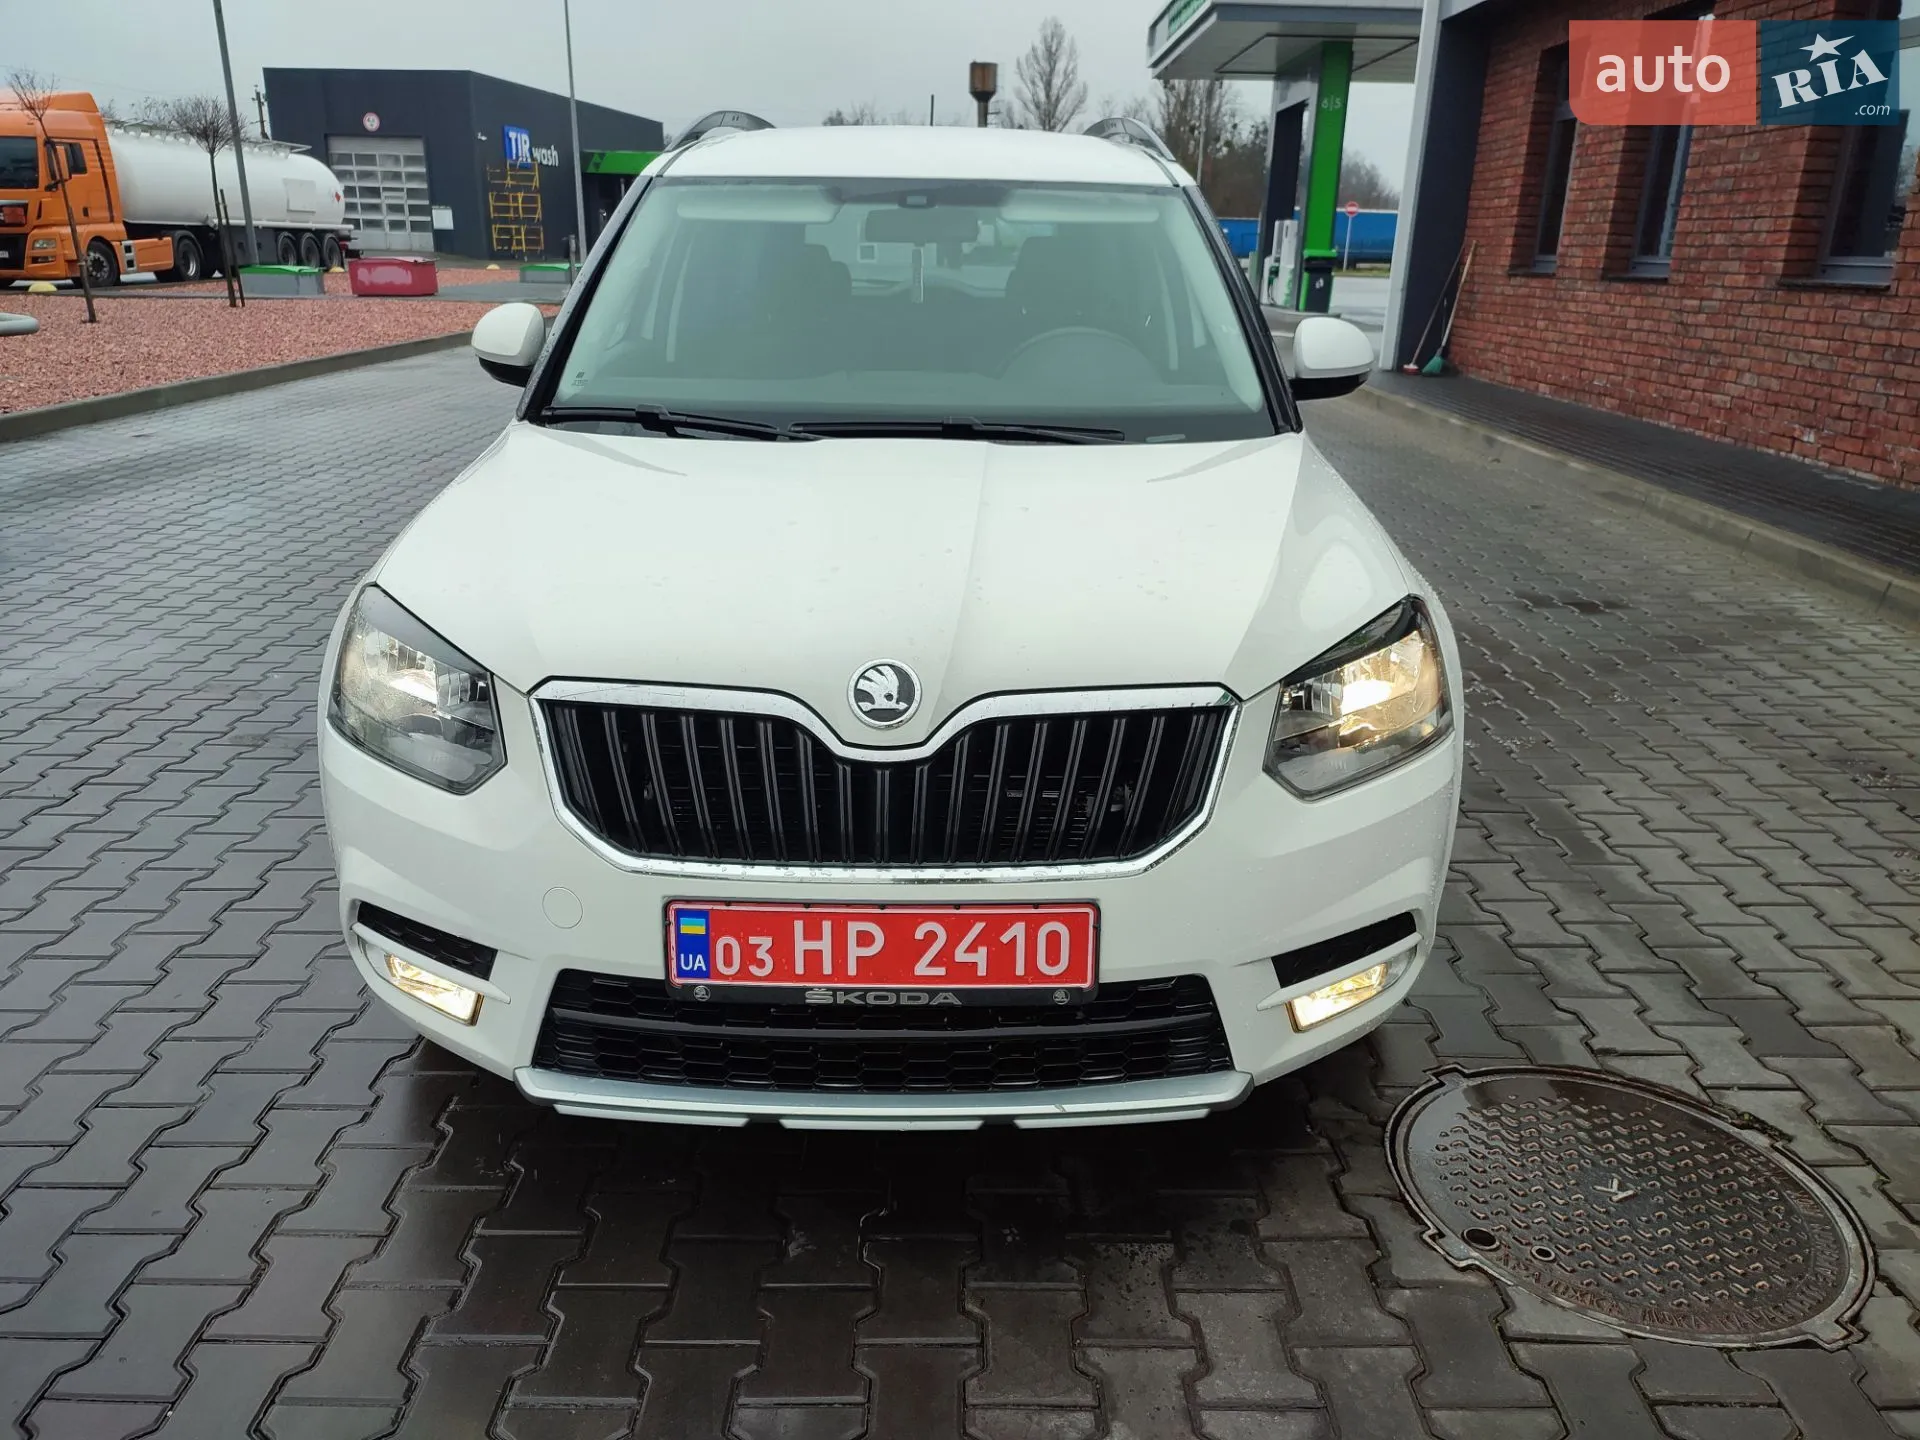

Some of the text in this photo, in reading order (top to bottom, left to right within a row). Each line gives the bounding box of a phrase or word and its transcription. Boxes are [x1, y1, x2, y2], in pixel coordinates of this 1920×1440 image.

[509, 131, 559, 167] TIR wash
[715, 920, 1071, 976] 03 HP 2410
[680, 953, 707, 972] UA
[805, 988, 962, 1005] ŠKODA
